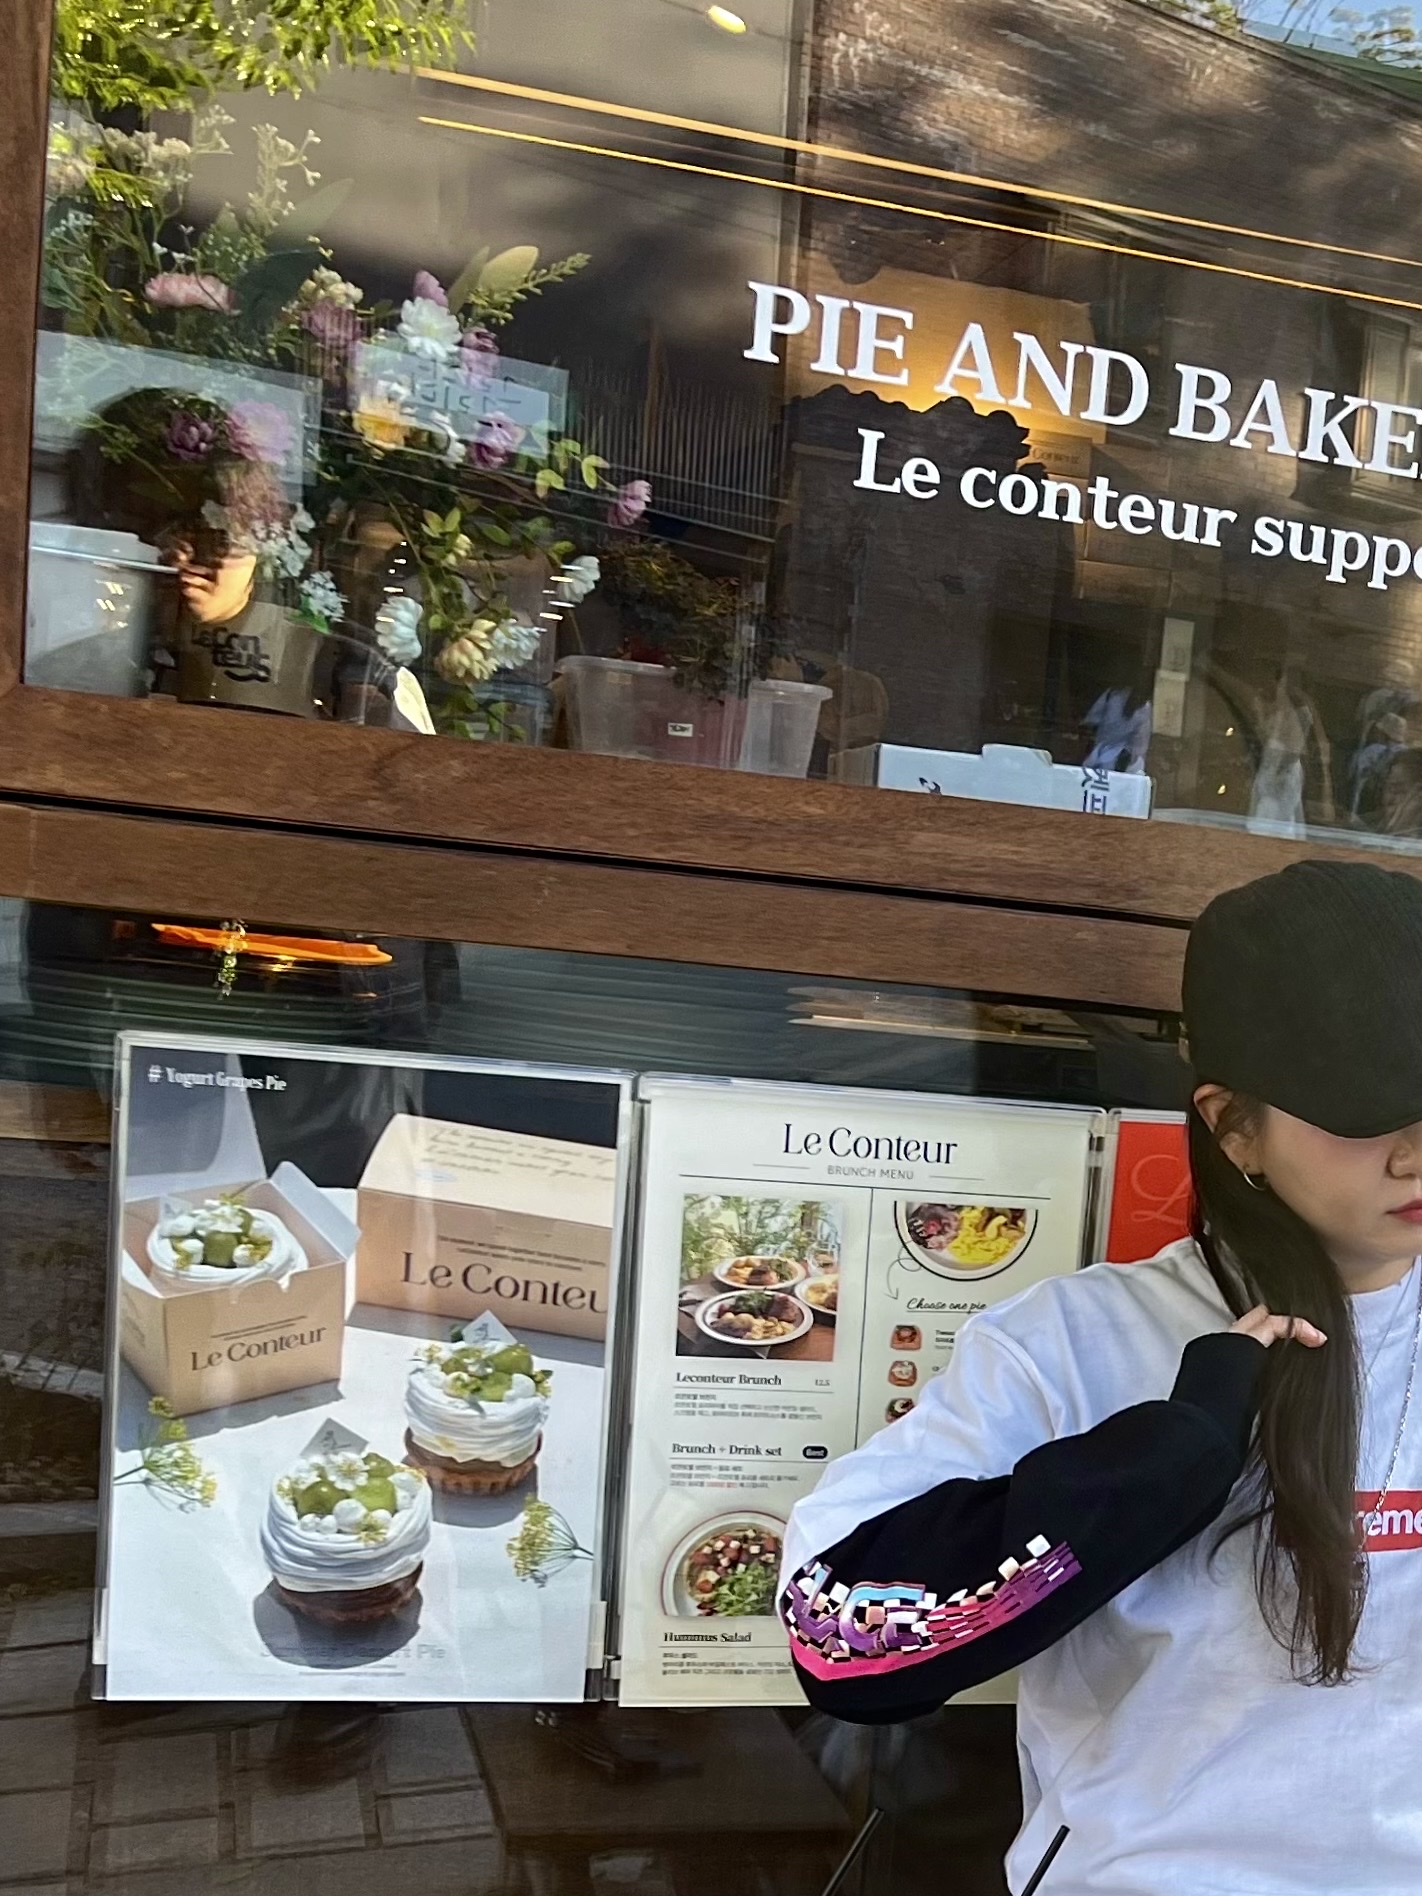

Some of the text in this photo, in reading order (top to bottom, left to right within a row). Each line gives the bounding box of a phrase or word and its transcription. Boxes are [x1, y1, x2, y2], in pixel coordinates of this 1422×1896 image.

[743, 281, 914, 386] PIE
[934, 322, 1149, 426] AND
[853, 427, 940, 499] Le
[960, 464, 1236, 548] conteur
[166, 1067, 214, 1088] Yogurt
[216, 1072, 263, 1091] Grapes
[266, 1075, 287, 1090] Pie
[783, 1123, 958, 1164] Le Conteur
[827, 1165, 914, 1180] BRUNCH MENU
[400, 1251, 453, 1289] Le
[907, 1298, 987, 1314] Choose one pie
[192, 1351, 223, 1371] Le
[227, 1327, 326, 1362] Conteur
[676, 1372, 735, 1384] Leconteur
[739, 1374, 782, 1386] Brunch
[672, 1443, 716, 1455] Brunch
[729, 1444, 762, 1456] Drink
[765, 1447, 782, 1456] set
[720, 1632, 752, 1642] Salad
